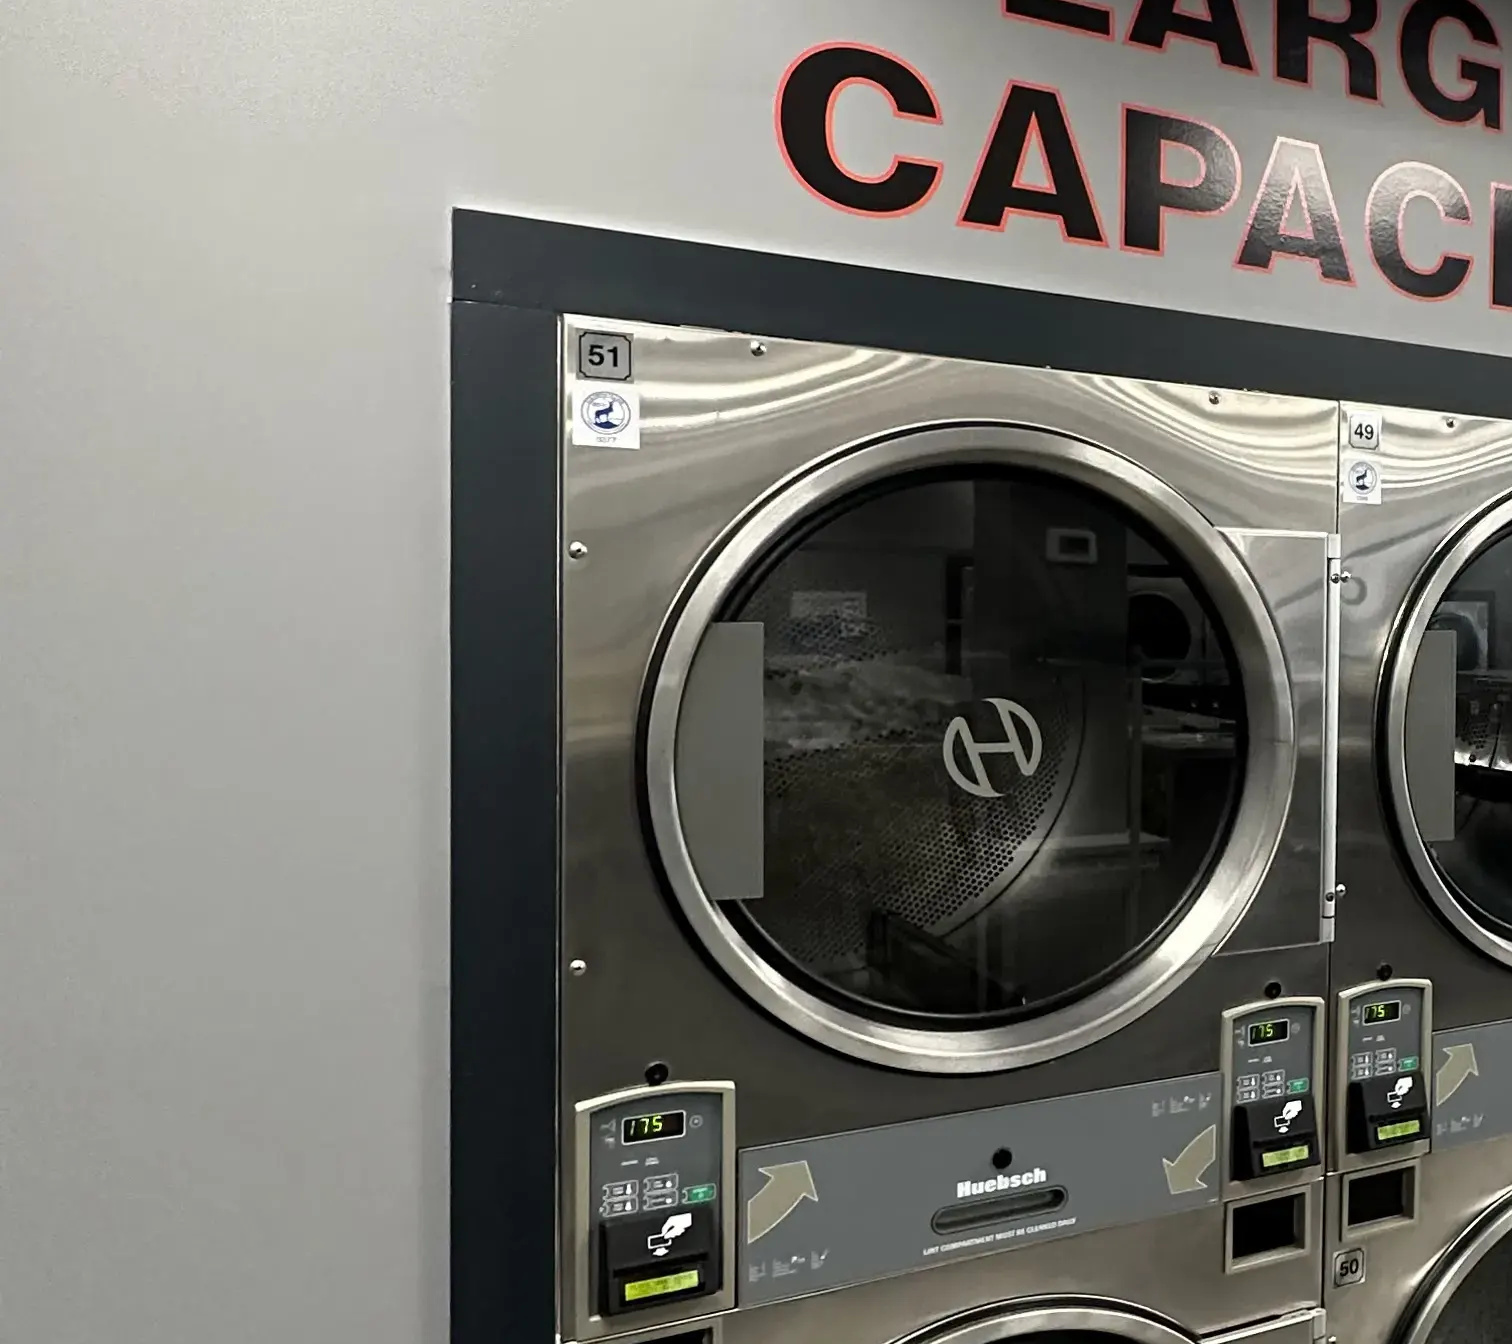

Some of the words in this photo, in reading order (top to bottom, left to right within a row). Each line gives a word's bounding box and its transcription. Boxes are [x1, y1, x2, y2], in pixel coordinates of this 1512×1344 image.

[587, 344, 619, 368] 51
[1353, 422, 1375, 441] 49
[629, 1115, 664, 1137] 175
[956, 1167, 1047, 1198] Huebsch
[1339, 1258, 1360, 1277] 50
